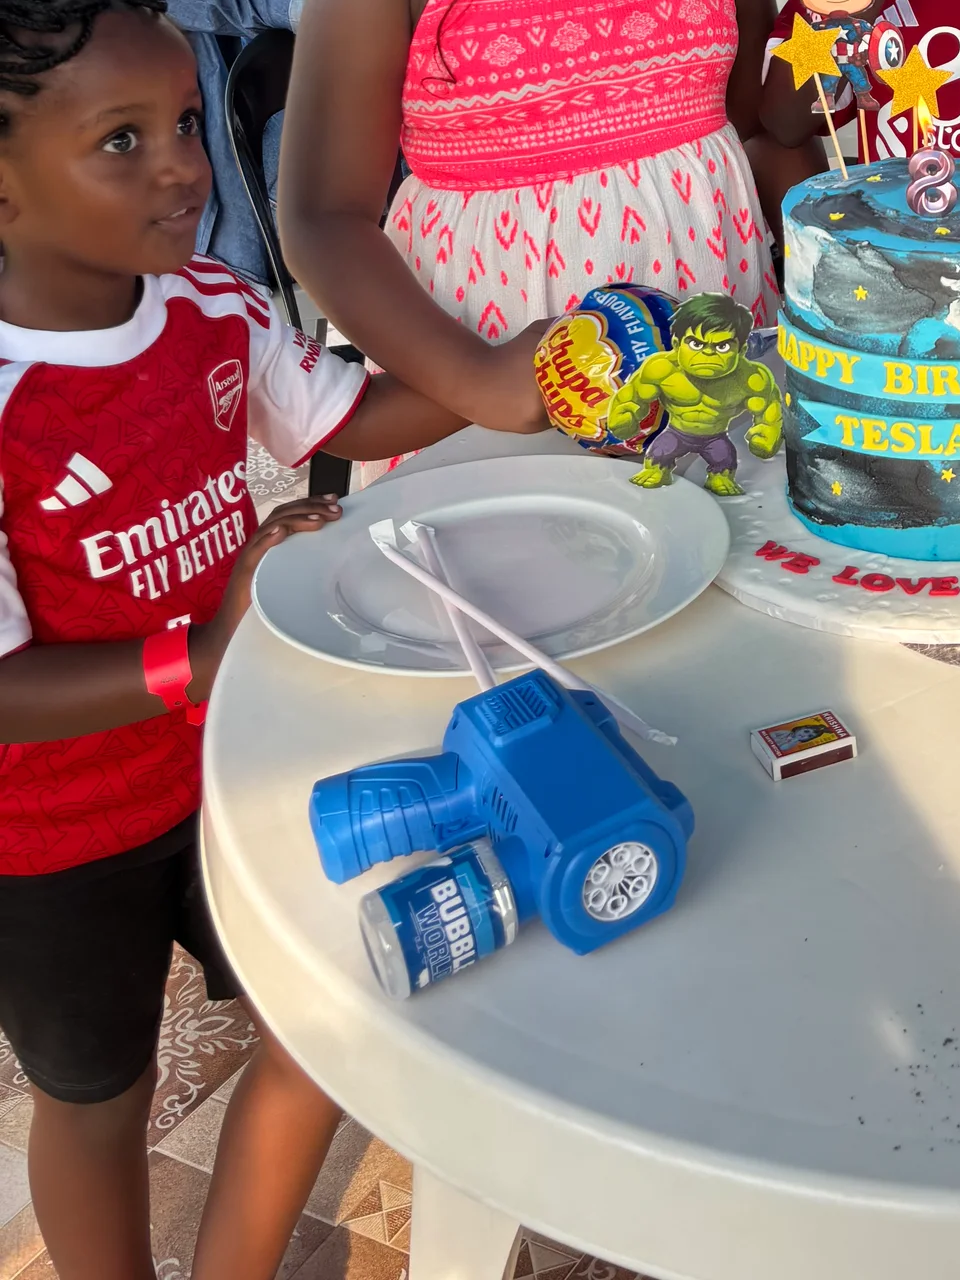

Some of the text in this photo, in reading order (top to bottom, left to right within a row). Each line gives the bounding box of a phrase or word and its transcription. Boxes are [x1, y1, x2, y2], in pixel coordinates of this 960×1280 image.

[906, 147, 958, 217] 8
[215, 370, 240, 393] Arsenal
[535, 346, 587, 429] Chups
[547, 325, 610, 408] Chupa
[80, 461, 248, 580] Emirates
[129, 510, 247, 600] FLY BETTER
[755, 540, 821, 574] WE
[832, 565, 960, 596] LOVE
[822, 711, 847, 738] KRISHNA
